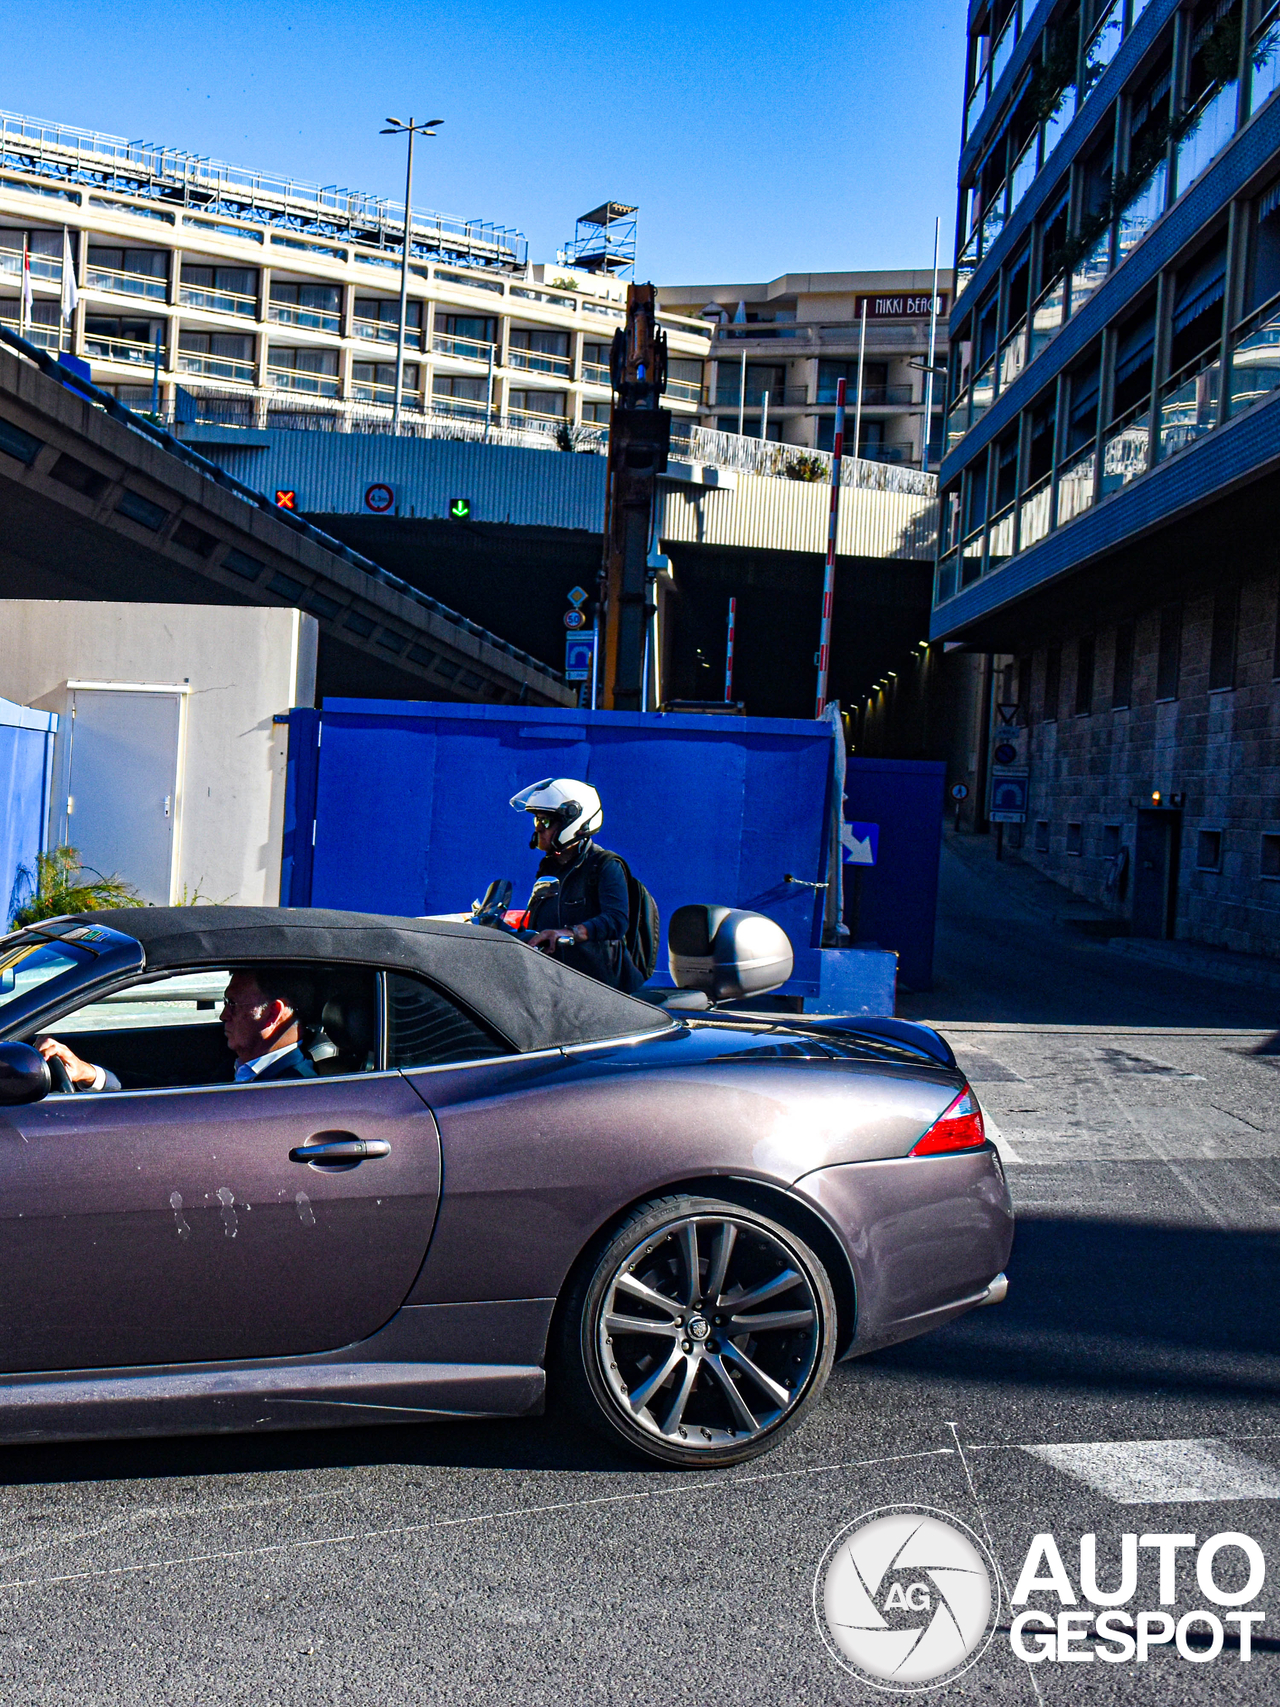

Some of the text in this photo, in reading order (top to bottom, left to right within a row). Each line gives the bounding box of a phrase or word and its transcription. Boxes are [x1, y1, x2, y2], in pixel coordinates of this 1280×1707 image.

[875, 296, 943, 314] NIKKI BEAC
[568, 615, 580, 624] 50
